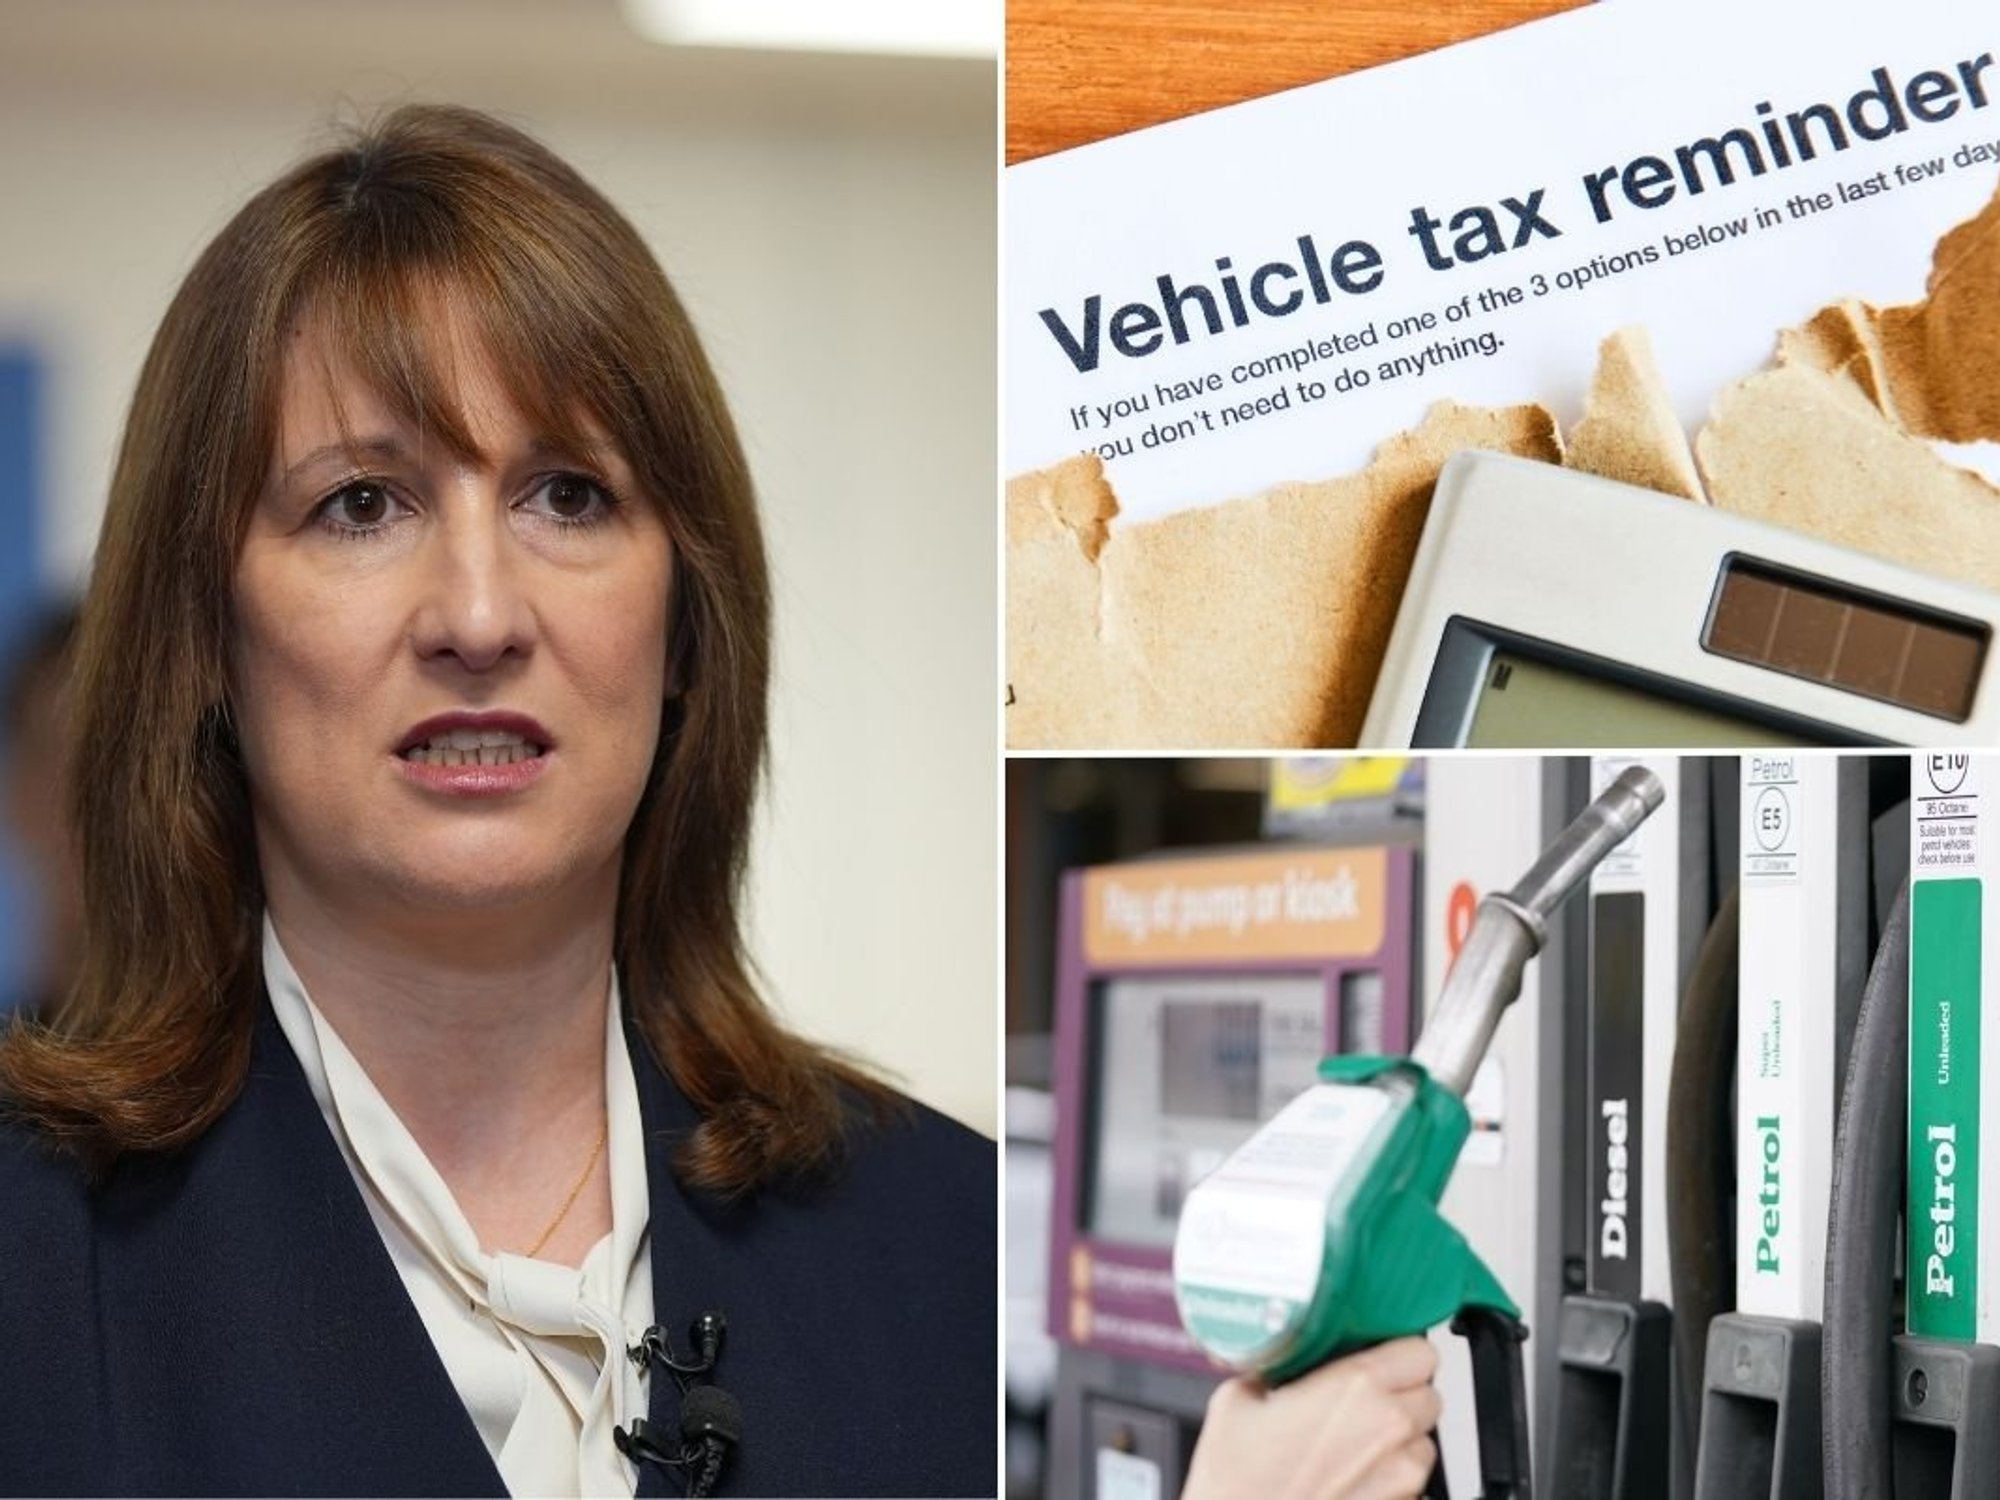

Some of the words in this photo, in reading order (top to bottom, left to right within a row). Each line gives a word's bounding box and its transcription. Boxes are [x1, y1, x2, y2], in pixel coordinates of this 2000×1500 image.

[1038, 234, 1384, 373] Vehicle
[1408, 189, 1564, 271] tax
[1583, 52, 1994, 223] reminder
[1070, 405, 1089, 430] If
[1097, 393, 1150, 428] you
[1156, 372, 1223, 406] have
[1231, 322, 1378, 385] completed
[1387, 311, 1437, 340] one
[1445, 296, 1473, 323] of
[1478, 284, 1524, 314] the
[1530, 274, 1549, 296] 3
[1555, 245, 1660, 290] options
[1664, 217, 1748, 257] below
[1754, 206, 1782, 229] in
[1787, 192, 1834, 219] the
[1837, 171, 1891, 201] last
[1894, 156, 1945, 186] few
[1953, 139, 2000, 168] day
[1081, 436, 1134, 461] ou
[1141, 410, 1214, 449] don't
[1221, 386, 1291, 426] need
[1296, 380, 1326, 403] to
[1334, 367, 1370, 392] do
[1379, 330, 1505, 381] anything.
[1753, 757, 1793, 779] Petrol
[1762, 808, 1782, 830] E5
[1938, 1001, 1950, 1085] Unleaded
[1601, 1098, 1628, 1260] Diesel
[1756, 1114, 1780, 1275] Petrol
[1927, 1122, 1956, 1297] Petrol
